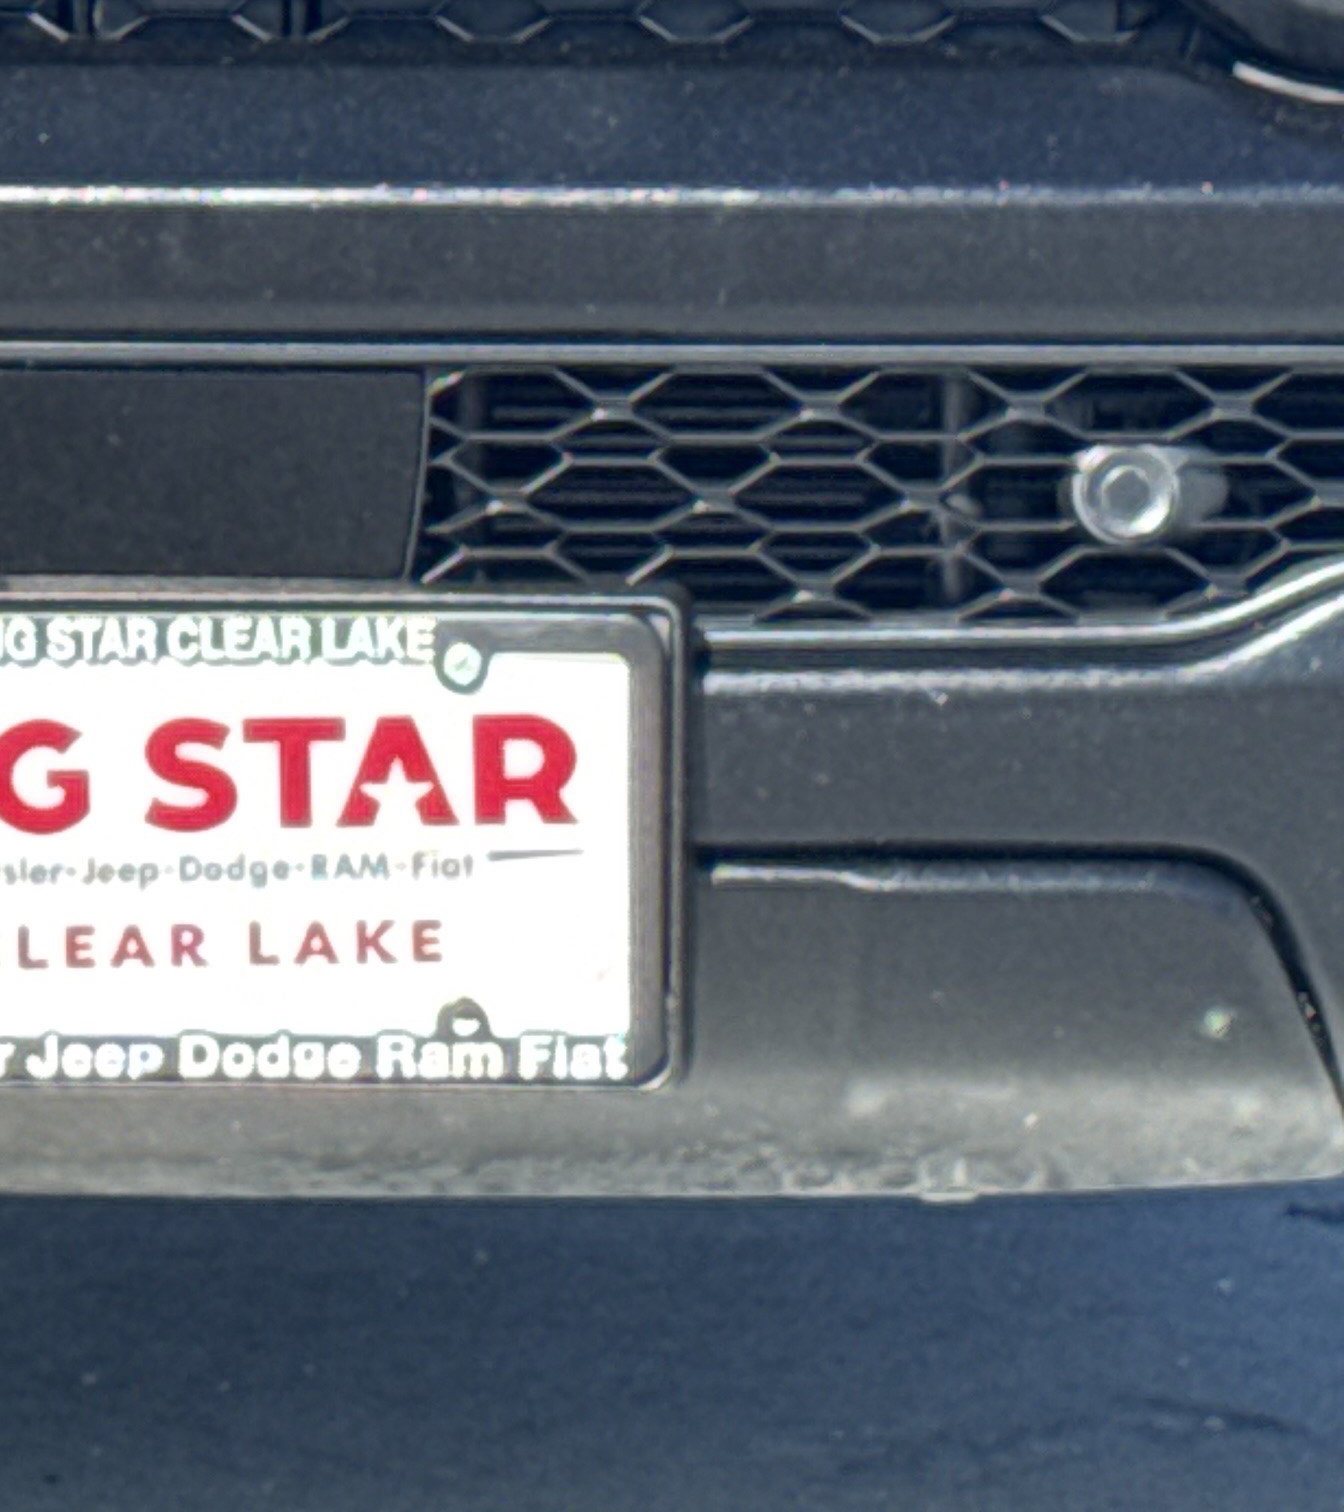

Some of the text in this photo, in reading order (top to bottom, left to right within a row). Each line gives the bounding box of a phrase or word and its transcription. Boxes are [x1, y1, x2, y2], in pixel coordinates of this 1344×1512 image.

[46, 617, 158, 662] STAR
[166, 616, 312, 662] CLEAR
[320, 616, 437, 661] LAKE
[144, 714, 579, 833] STAR
[248, 918, 444, 966] LAKE
[25, 1033, 165, 1081] Jeep
[178, 1032, 362, 1080] Dodge
[375, 1034, 504, 1080] Ram
[517, 1034, 629, 1080] Fiat
